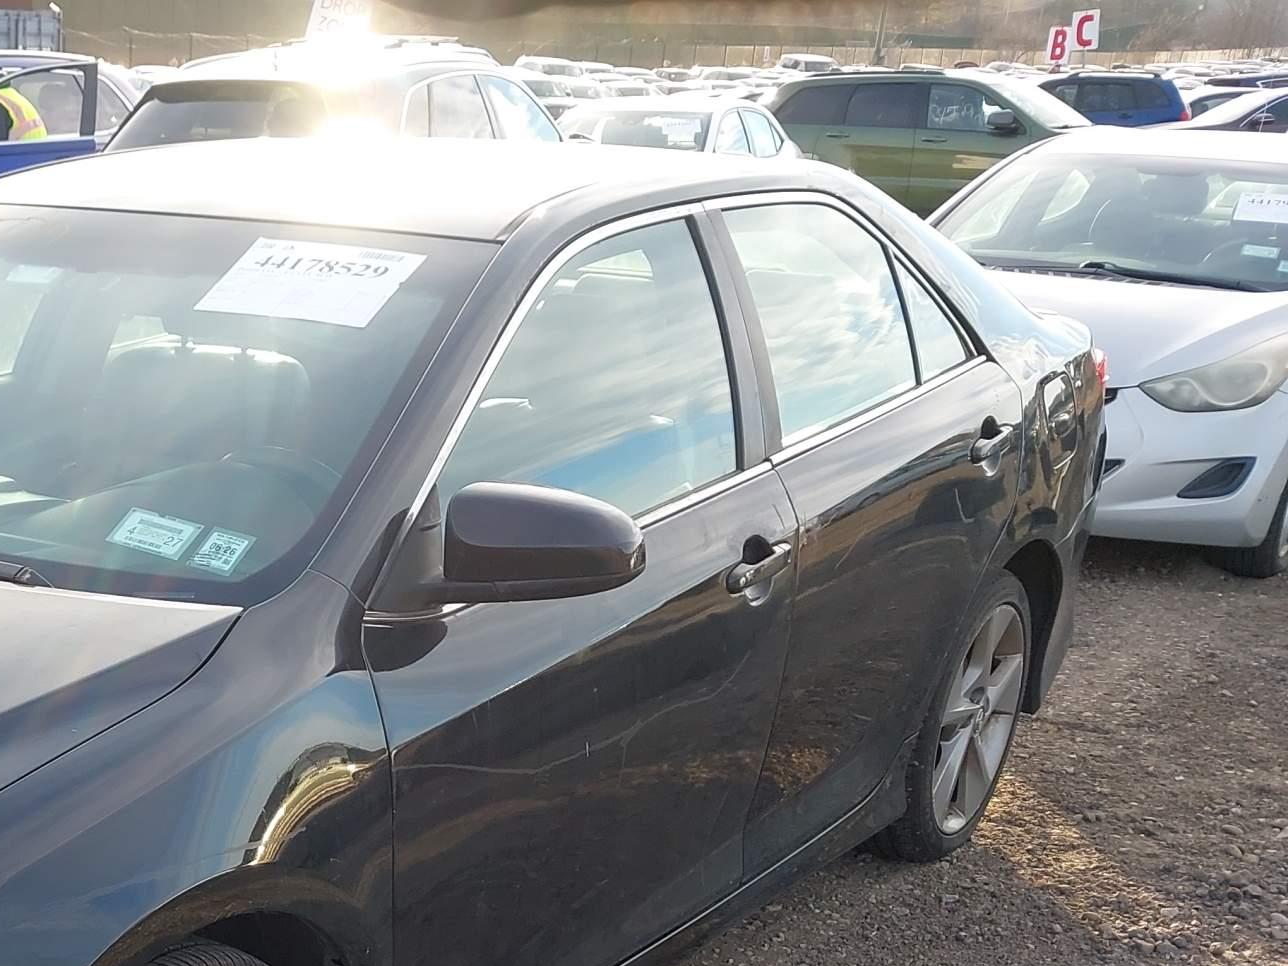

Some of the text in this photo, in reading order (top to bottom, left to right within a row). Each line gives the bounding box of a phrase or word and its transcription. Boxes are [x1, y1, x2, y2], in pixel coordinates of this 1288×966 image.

[1050, 29, 1067, 60] B
[1077, 15, 1094, 47] C
[254, 255, 390, 279] 44178529
